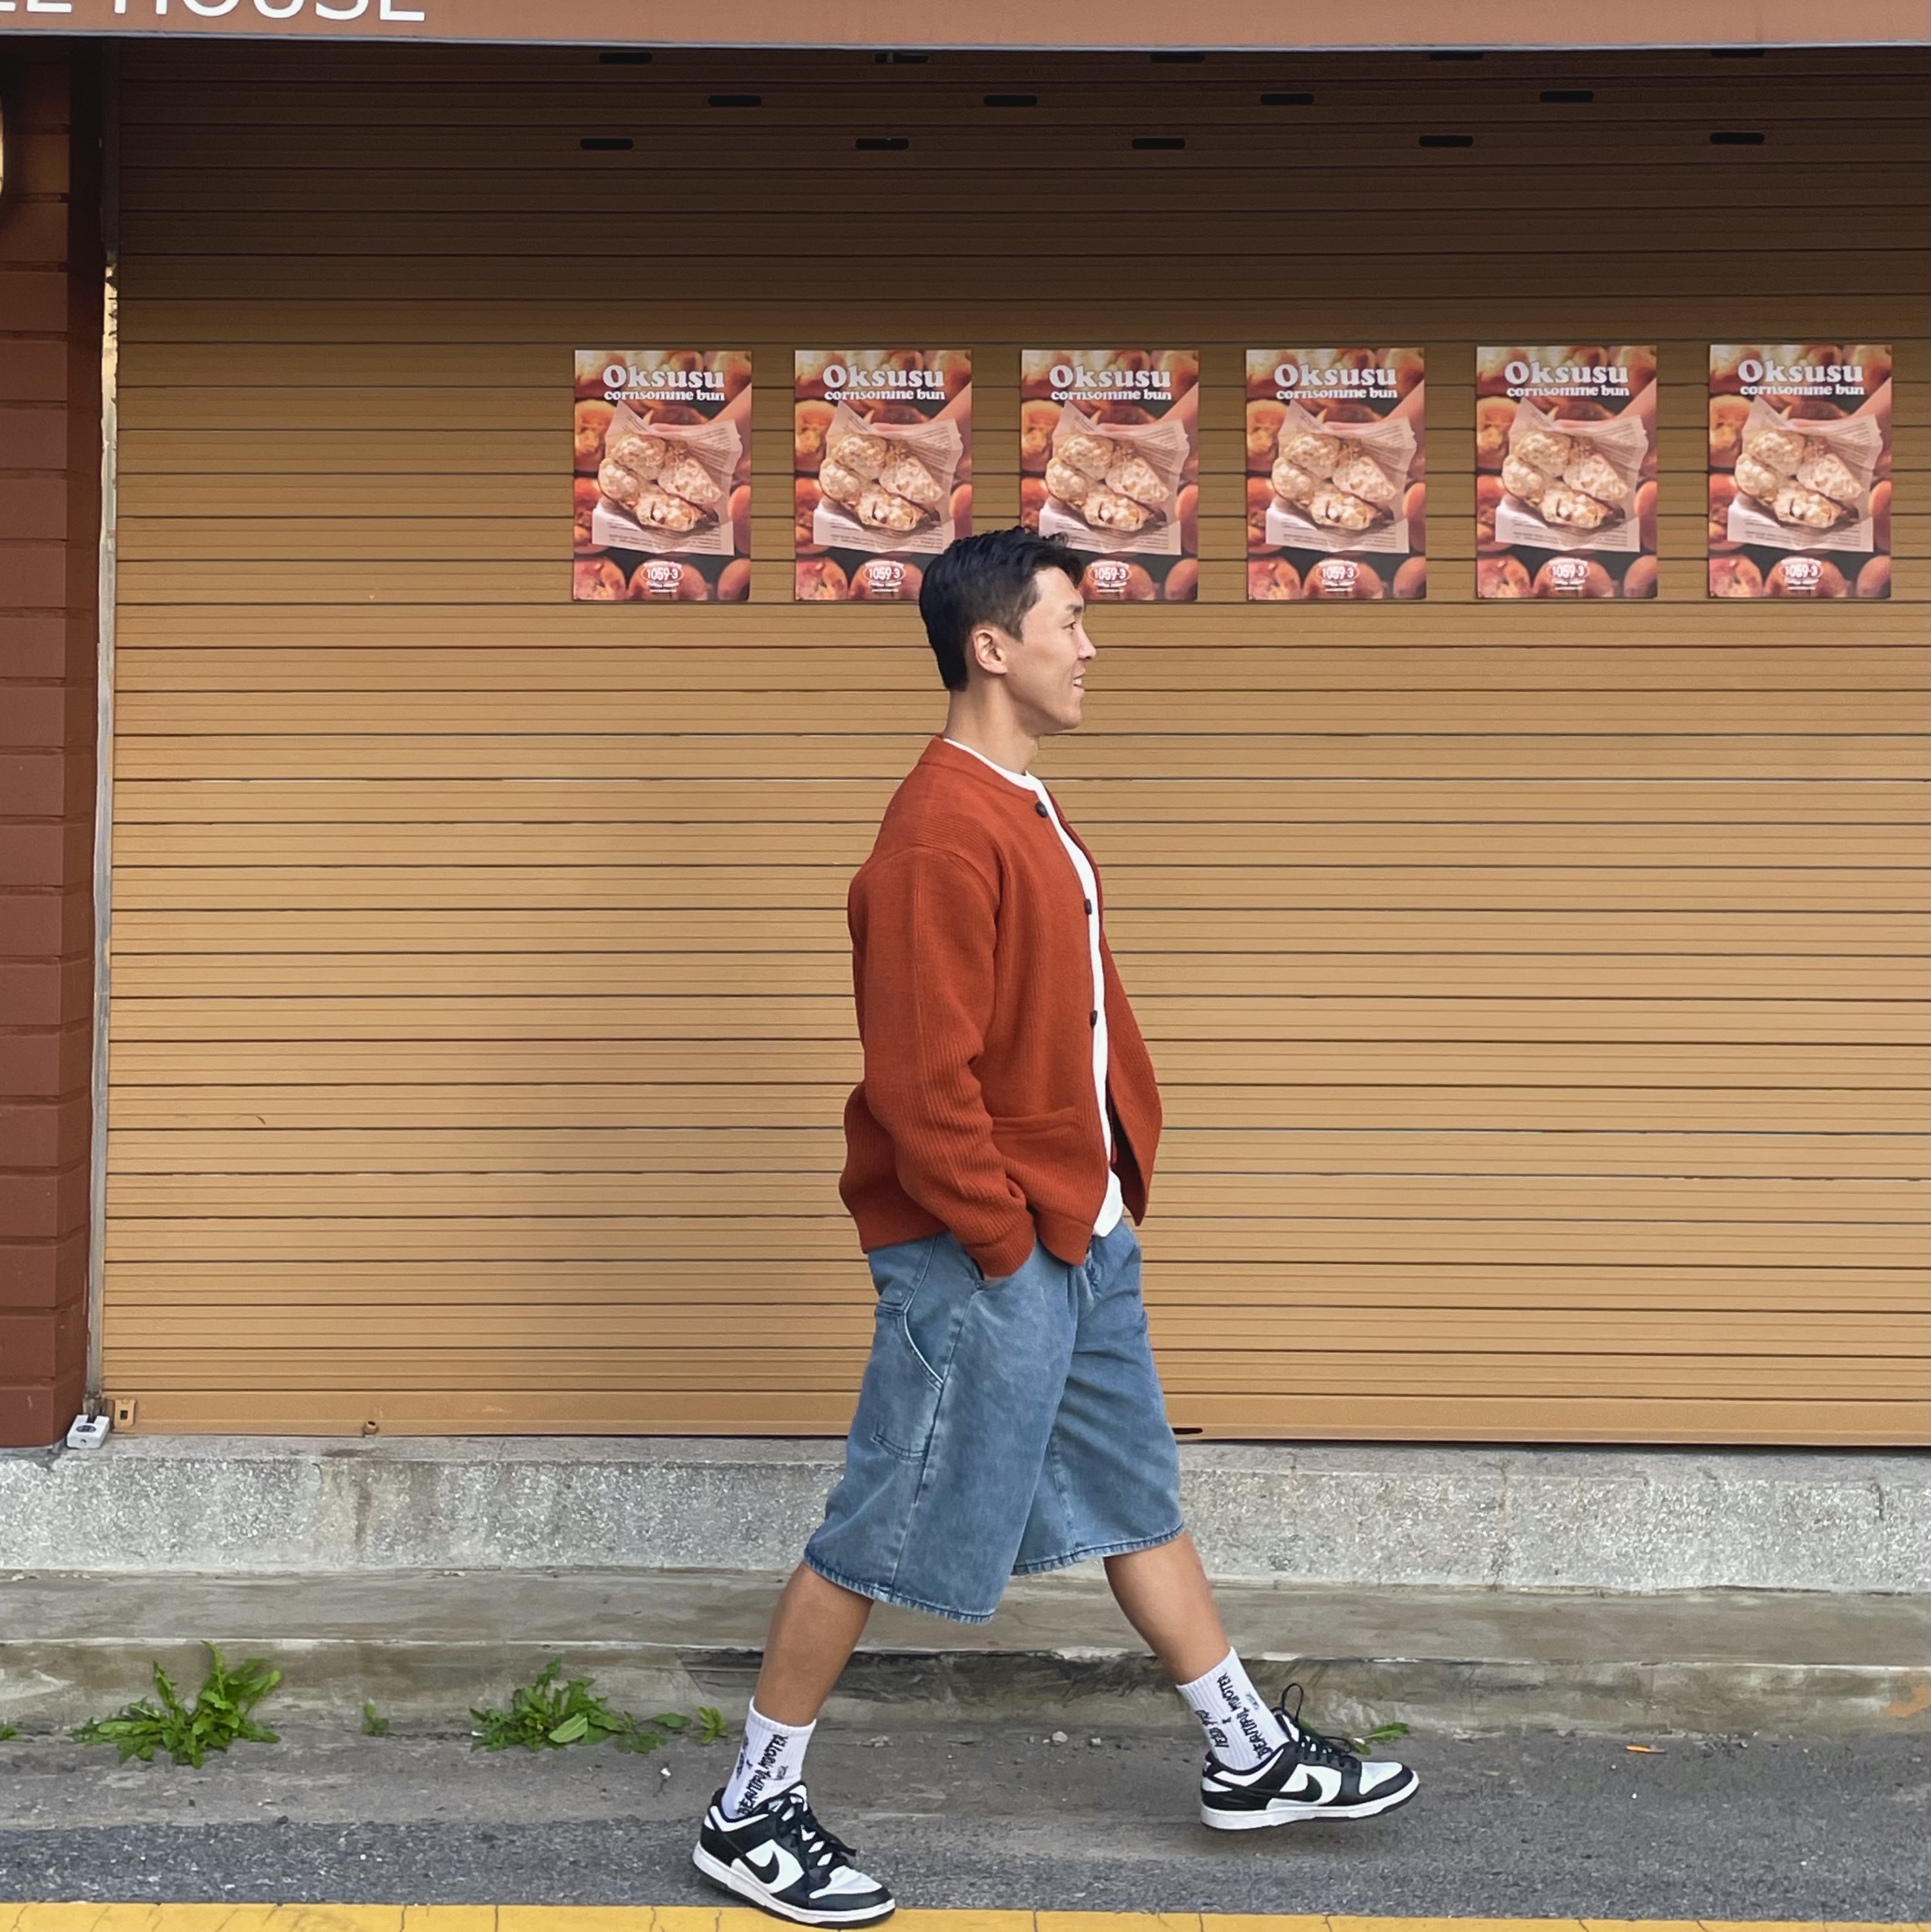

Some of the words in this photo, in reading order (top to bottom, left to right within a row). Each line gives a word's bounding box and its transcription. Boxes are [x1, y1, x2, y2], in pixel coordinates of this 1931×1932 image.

[603, 364, 724, 388] Oksusu
[823, 365, 945, 388] Oksusu
[1049, 365, 1171, 388] Oksusu
[1274, 364, 1396, 387] Oksusu
[1505, 362, 1628, 384] Oksusu
[1738, 360, 1863, 382] Oksusu
[604, 390, 694, 401] cornsomme
[697, 390, 725, 401] bun
[824, 390, 913, 400] cornsomme
[917, 389, 945, 400] bun
[1051, 390, 1140, 400] cornsomme
[1143, 389, 1171, 400] bun
[1276, 389, 1366, 399] cornsomme
[1369, 388, 1398, 399] bun
[1507, 386, 1598, 397] cornsomme
[1602, 386, 1629, 396] bun
[1740, 385, 1832, 395] cornsomme
[1836, 384, 1864, 395] bun
